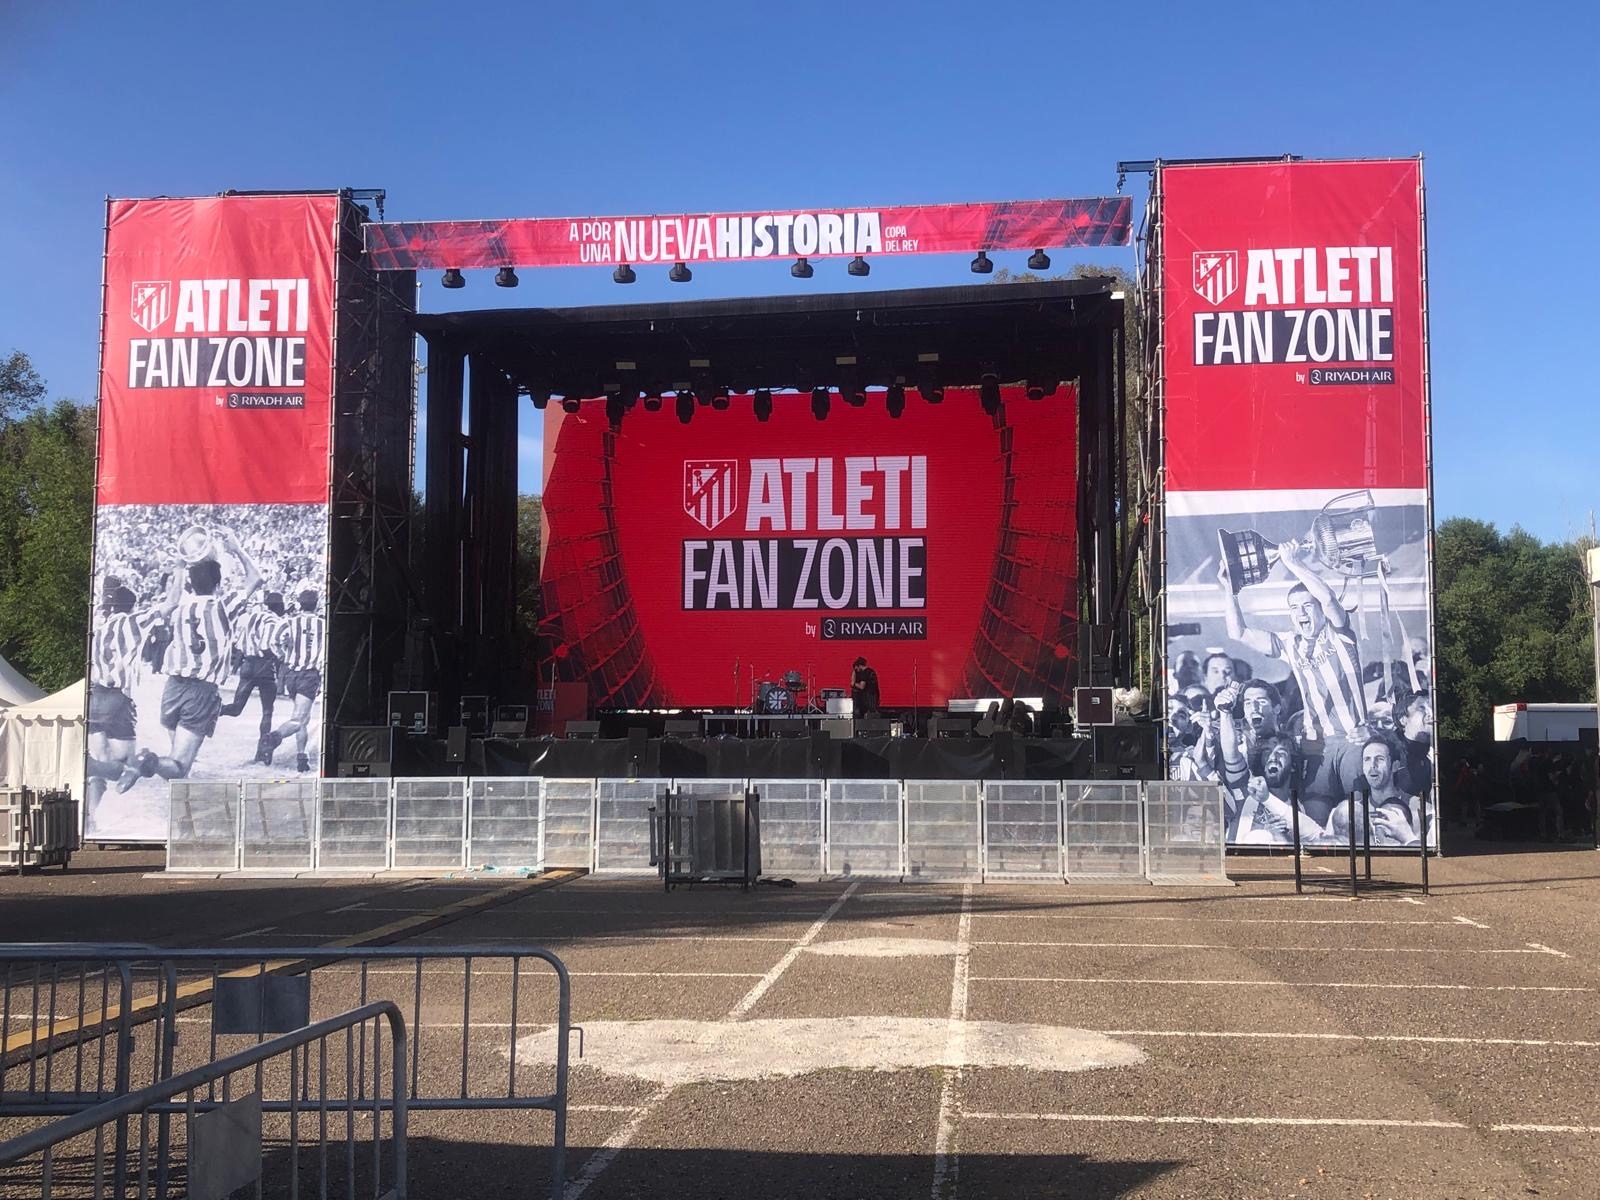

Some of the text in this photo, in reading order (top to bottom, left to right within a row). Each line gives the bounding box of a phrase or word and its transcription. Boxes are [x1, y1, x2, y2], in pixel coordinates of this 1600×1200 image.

[569, 222, 610, 240] A POR
[614, 212, 882, 262] NUEVA HISTORIA
[885, 226, 908, 238] COPA
[886, 238, 918, 252] DEL REY
[580, 243, 610, 262] UNA
[1244, 246, 1394, 306] ATLETI
[174, 278, 308, 332] ATLETI
[1194, 308, 1393, 365] FAN ZONE
[128, 336, 306, 388] FAN ZONE
[1296, 371, 1392, 384] by RIYADH AIR
[215, 395, 303, 408] by RIYADH AIR
[744, 455, 927, 531] ATLETI
[684, 537, 925, 610] FAN ZONE
[805, 622, 924, 638] by RIYADH AIR
